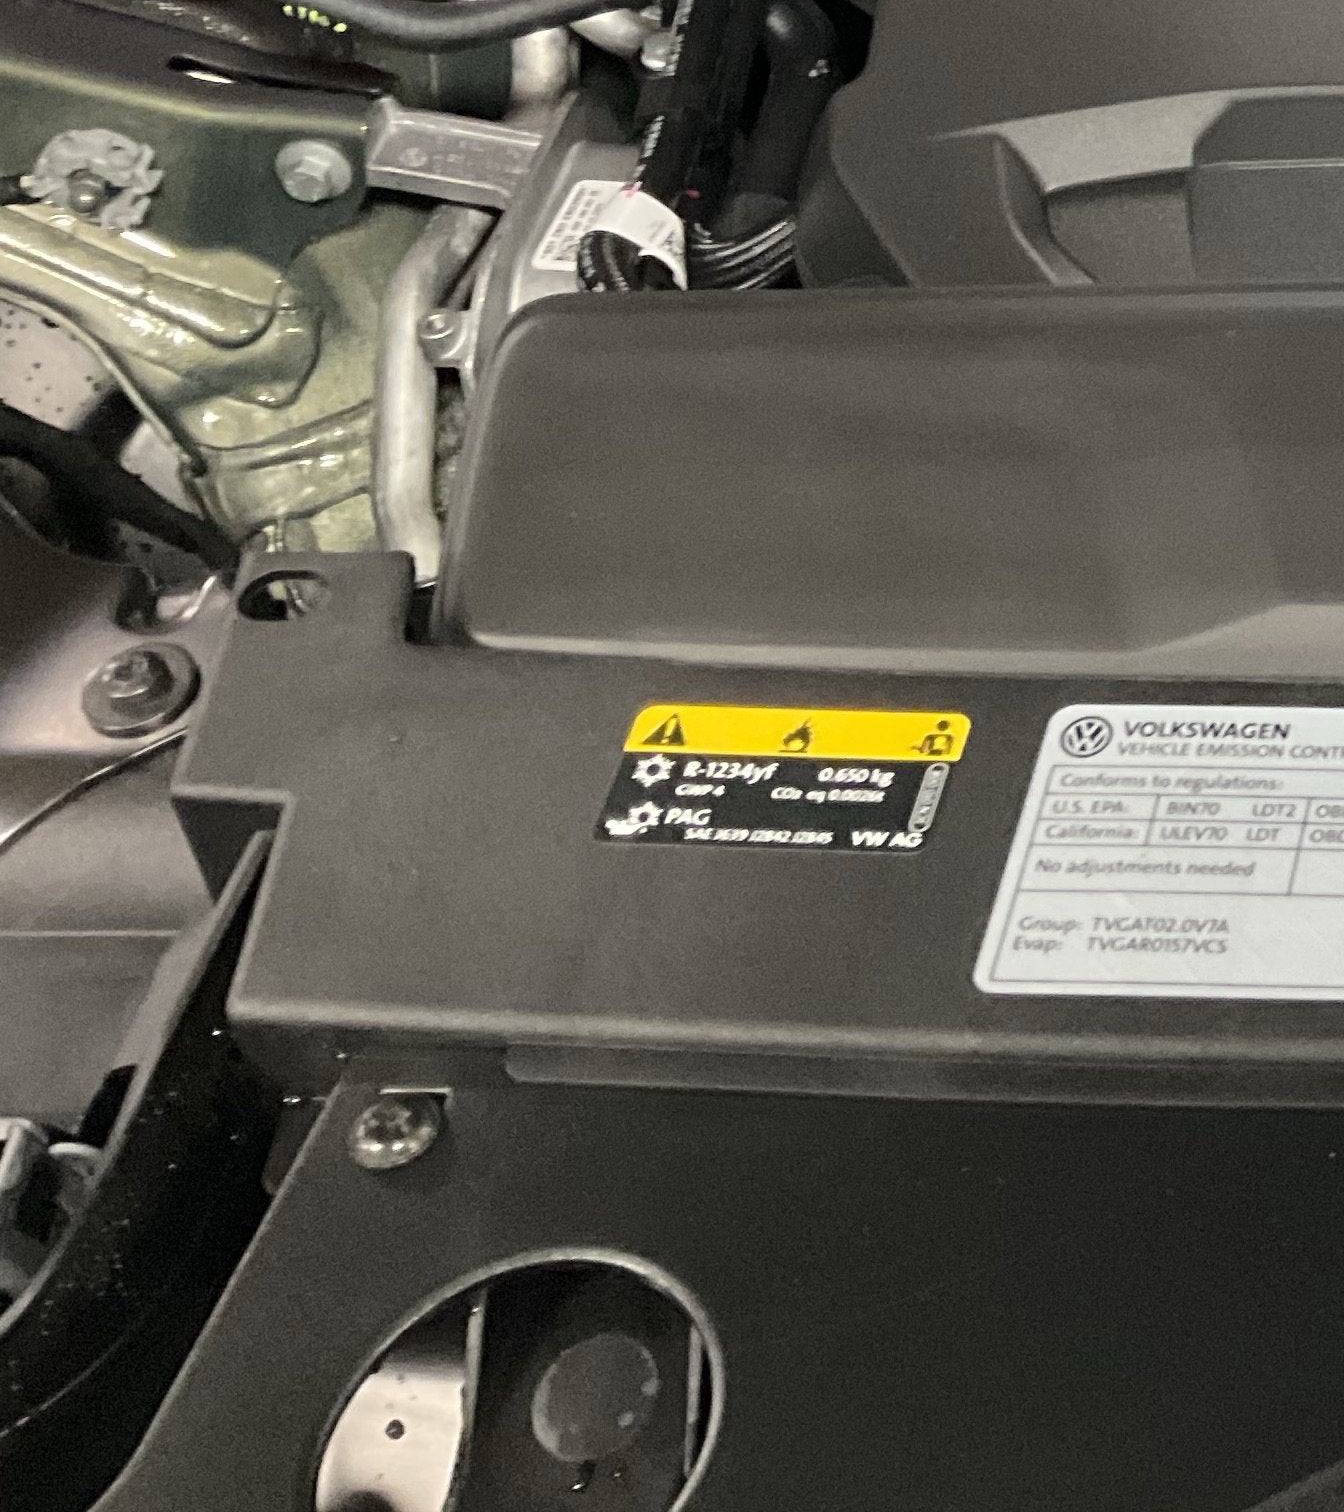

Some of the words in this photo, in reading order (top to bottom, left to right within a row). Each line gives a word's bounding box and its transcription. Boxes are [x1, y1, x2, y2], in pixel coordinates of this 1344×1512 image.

[1124, 721, 1291, 739] VOLKSWAGEN
[1117, 741, 1188, 757] VEHICLE
[1196, 743, 1283, 758] EMISSION
[683, 760, 779, 785] R-1234yf
[817, 767, 870, 783] 0.650
[869, 768, 896, 788] kg
[1060, 773, 1147, 788] Conforms
[1152, 774, 1171, 788] to
[1176, 775, 1284, 794] regulations:
[1052, 799, 1085, 814] U.S.
[1166, 801, 1221, 816] BIN70
[1252, 803, 1297, 818] LDT2
[664, 807, 713, 826] PAG
[851, 831, 889, 847] VW
[888, 832, 923, 848] AG
[1045, 823, 1136, 839] California:
[1160, 825, 1229, 841] ULEV70
[1246, 827, 1281, 841] LDT
[1034, 859, 1062, 873] No
[1066, 859, 1182, 878] adjustments
[1186, 861, 1257, 877] needed
[1018, 916, 1082, 935] Group:
[1012, 936, 1064, 954] Evap:
